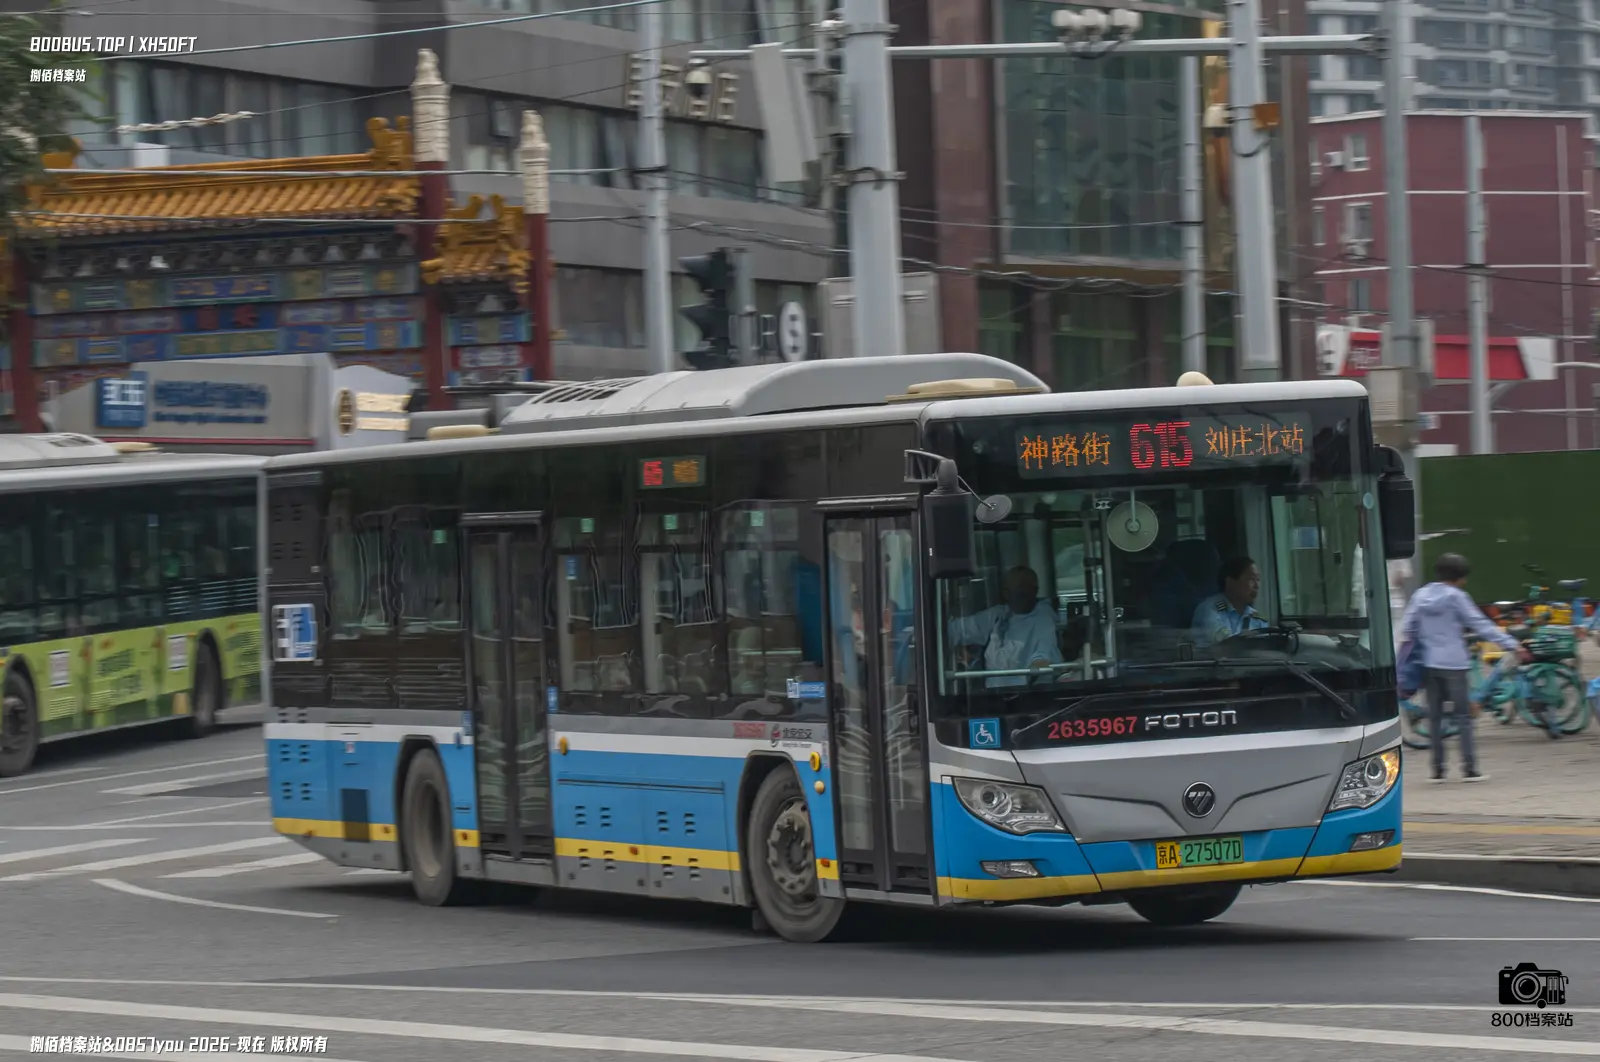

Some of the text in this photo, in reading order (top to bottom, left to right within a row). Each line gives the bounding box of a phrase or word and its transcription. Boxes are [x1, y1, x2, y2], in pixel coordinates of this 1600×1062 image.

[1019, 421, 1304, 469] 神路街 615 刘庄北站
[1047, 710, 1237, 739] 2635967 FOTON
